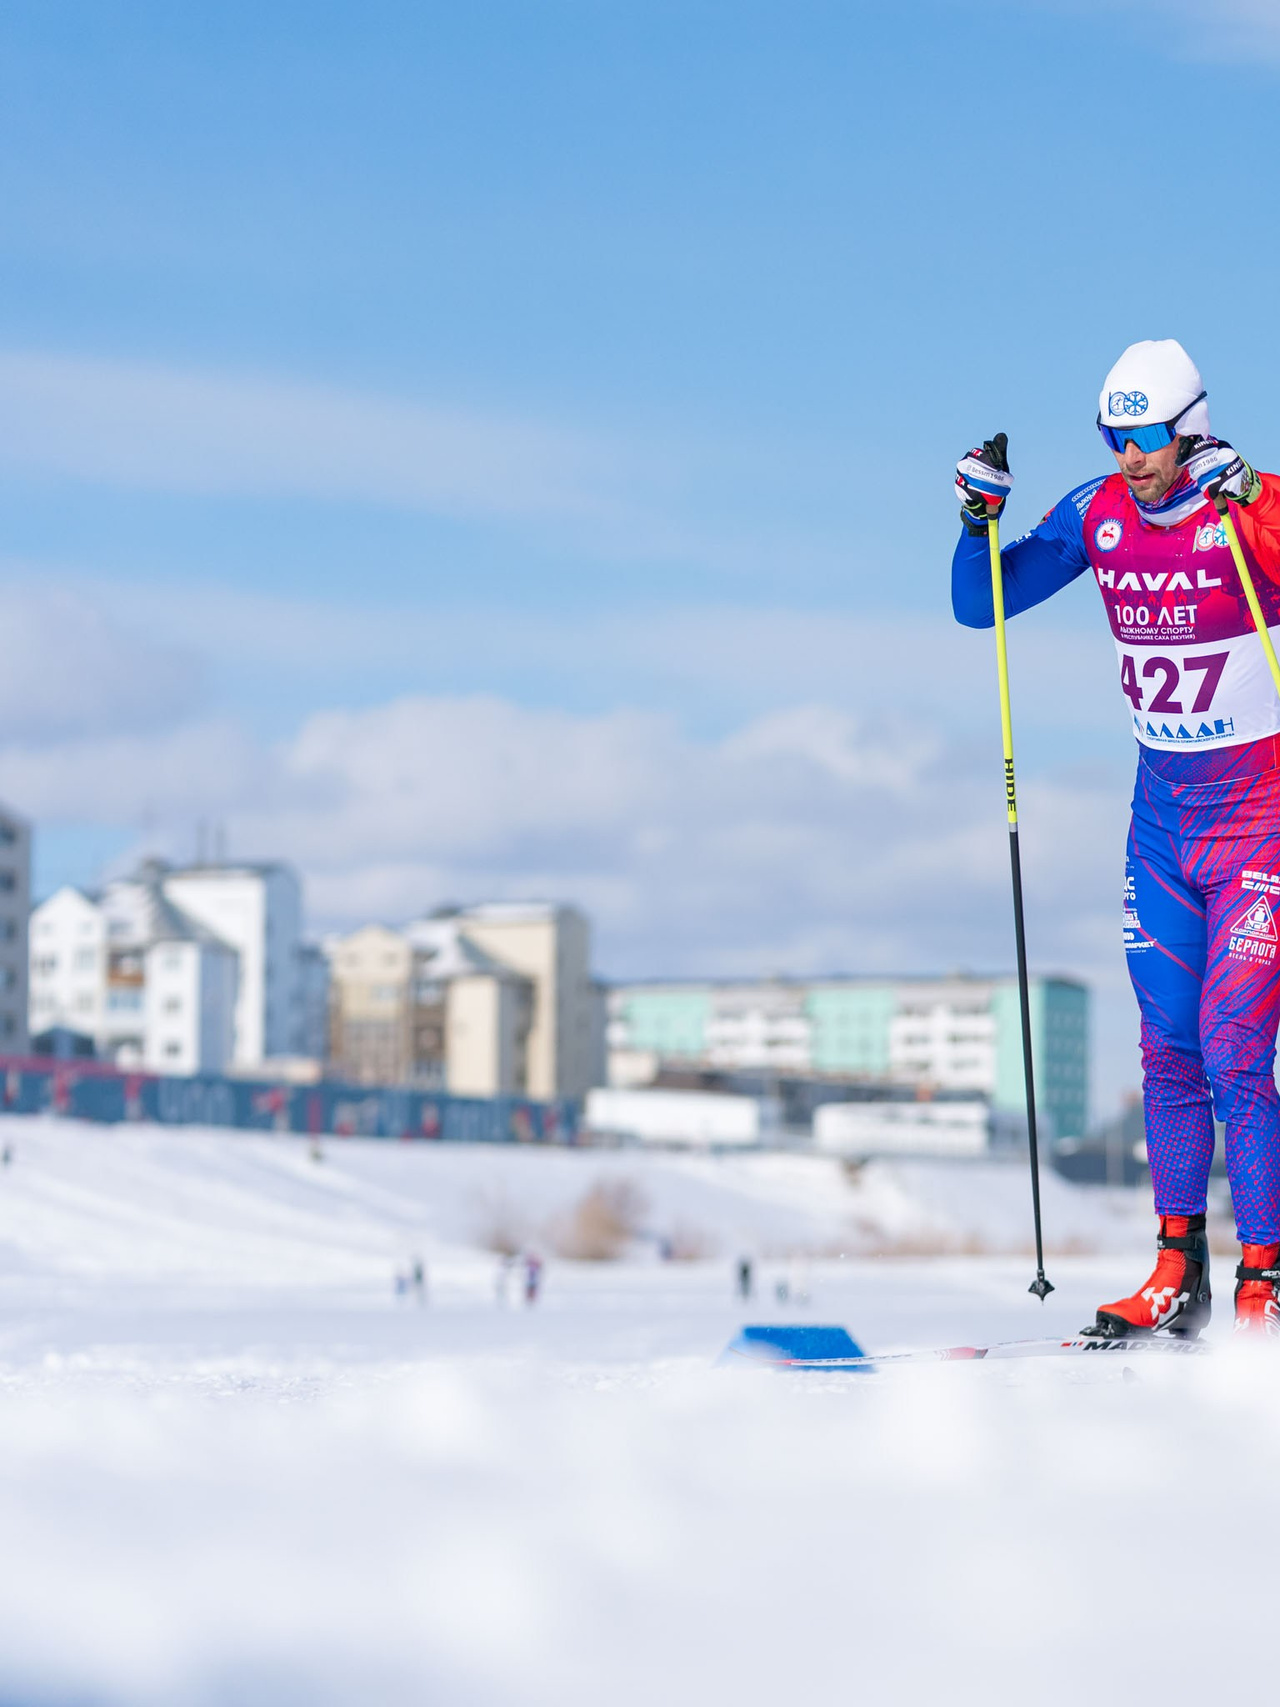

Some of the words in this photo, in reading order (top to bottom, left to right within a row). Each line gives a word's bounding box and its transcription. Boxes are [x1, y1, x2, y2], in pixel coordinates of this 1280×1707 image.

[1097, 567, 1222, 592] HAVAL
[1114, 604, 1150, 626] 100
[1156, 604, 1198, 626] ЛЕТ
[1160, 626, 1194, 635] СПОРТУ
[1121, 651, 1231, 714] 427
[1004, 758, 1017, 812] HIDE
[1228, 936, 1277, 959] БЕРЛОГА
